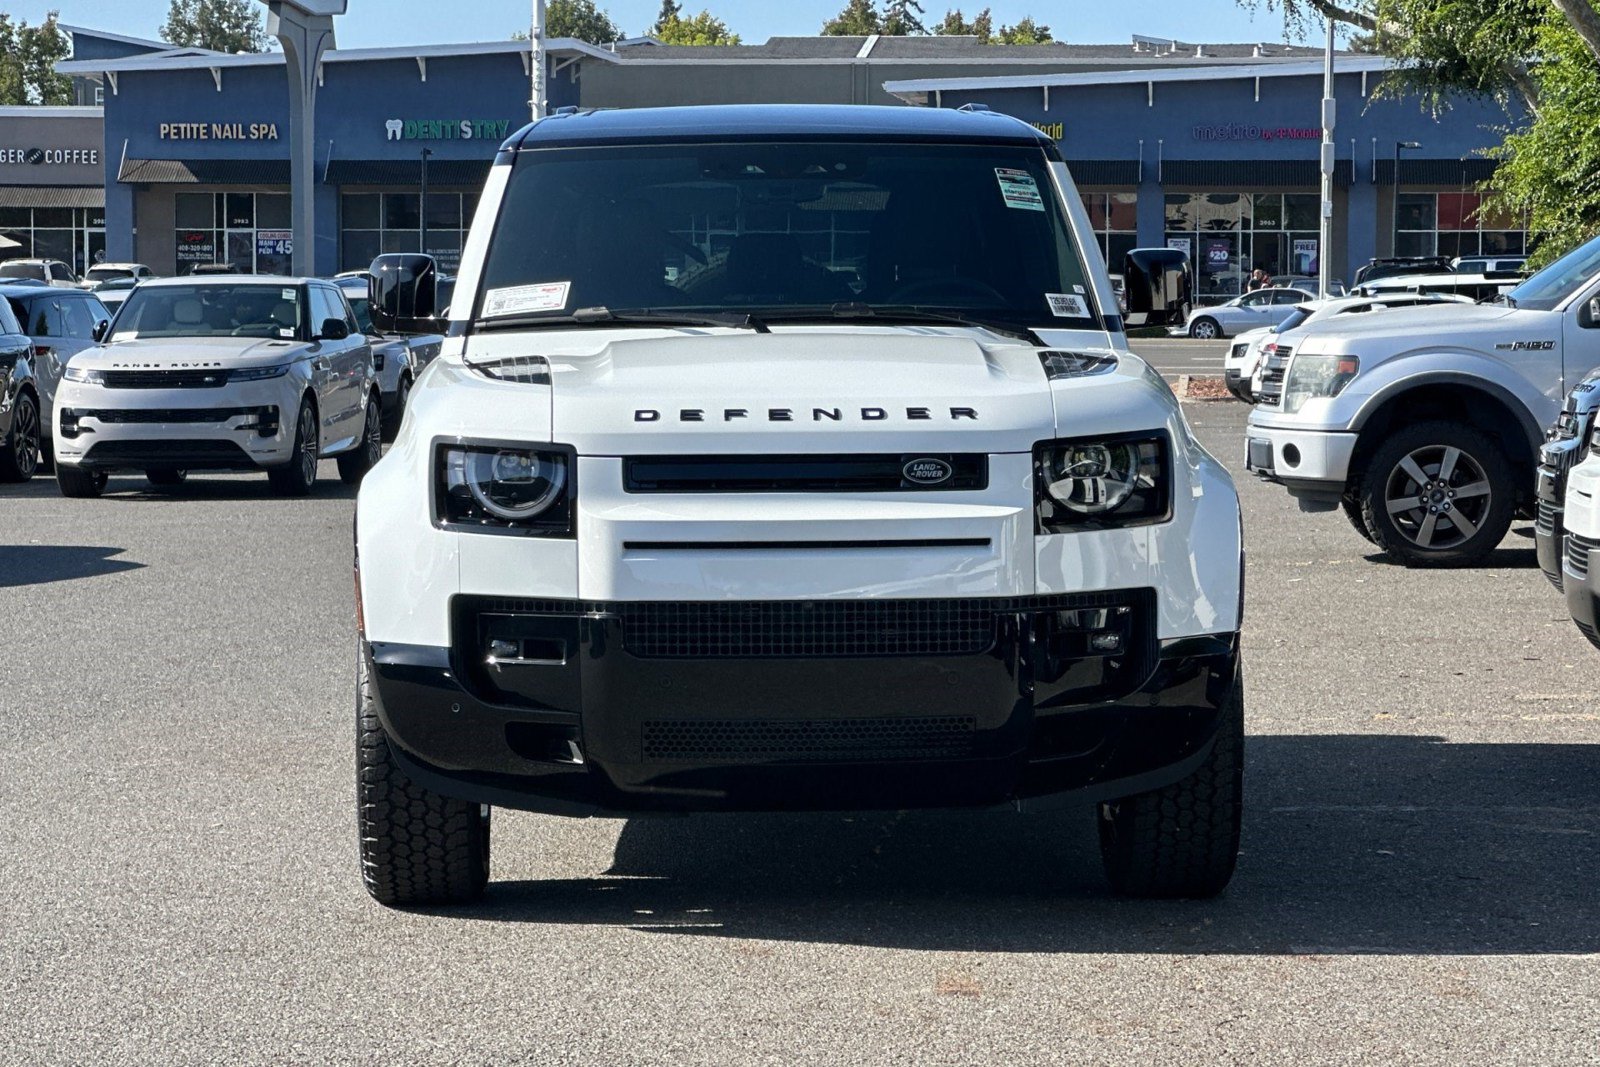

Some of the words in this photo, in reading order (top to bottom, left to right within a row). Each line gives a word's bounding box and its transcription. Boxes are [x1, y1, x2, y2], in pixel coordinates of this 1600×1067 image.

[160, 123, 208, 140] PETITE
[211, 123, 246, 140] NAIL
[249, 123, 279, 140] SPA
[404, 119, 510, 140] DENTISTRY
[45, 149, 98, 164] COFFEE
[275, 240, 294, 255] 45
[1295, 243, 1316, 251] FREE
[1209, 250, 1229, 261] $20
[634, 407, 979, 422] DEFENDER
